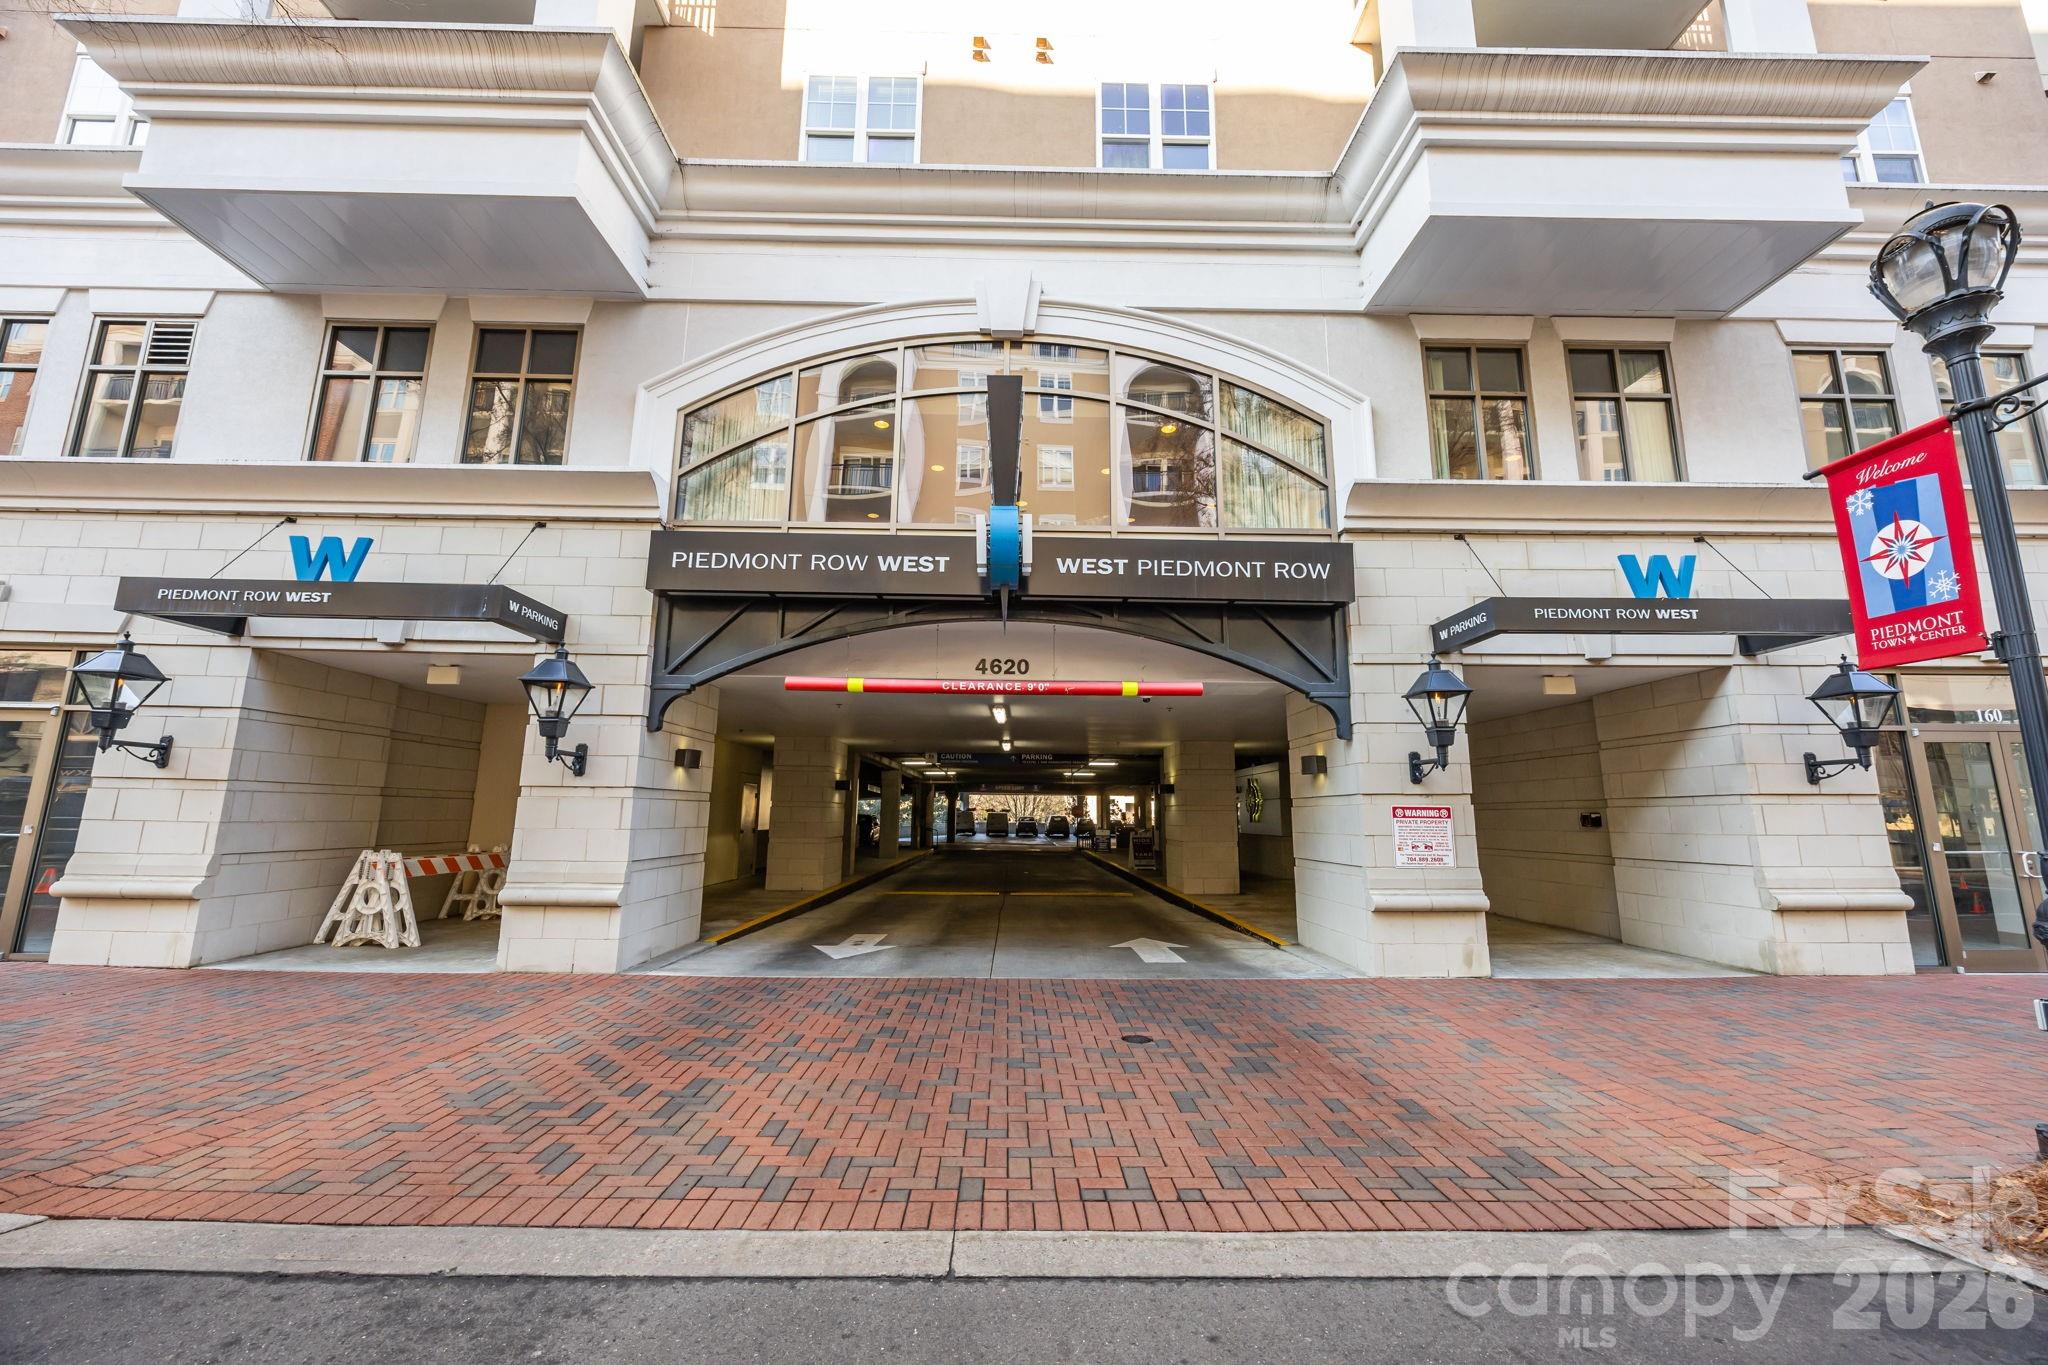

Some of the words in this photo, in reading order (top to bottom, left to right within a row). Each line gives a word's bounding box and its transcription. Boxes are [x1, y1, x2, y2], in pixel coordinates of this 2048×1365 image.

[1856, 452, 1928, 485] Welcome
[289, 535, 374, 582] W
[671, 551, 803, 571] PIEDMONT
[810, 554, 869, 571] ROW
[877, 555, 950, 573] WEST
[1056, 557, 1129, 575] WEST
[1137, 559, 1266, 579] PIEDMONT
[1273, 562, 1331, 580] ROW
[1617, 554, 1697, 599] W
[157, 588, 240, 600] PIEDMONT
[243, 590, 281, 601] ROW
[285, 591, 332, 604] WEST
[508, 599, 520, 613] W
[521, 605, 559, 631] PARKING
[1534, 608, 1611, 620] PIEDMONT
[1616, 608, 1650, 620] ROW
[1655, 609, 1699, 620] WEST
[1439, 628, 1449, 640] W
[1449, 612, 1488, 636] PARKING
[1870, 610, 1963, 641] PIEDMONT
[1871, 636, 1907, 650] TOWN
[1919, 624, 1967, 641] CENTER
[975, 658, 1030, 675] 4620
[942, 681, 1021, 691] CLEARANCE
[1975, 708, 2003, 724] 160
[940, 753, 973, 761] CAUTION
[1021, 754, 1054, 762] PARKING
[1404, 809, 1440, 817] WARNING
